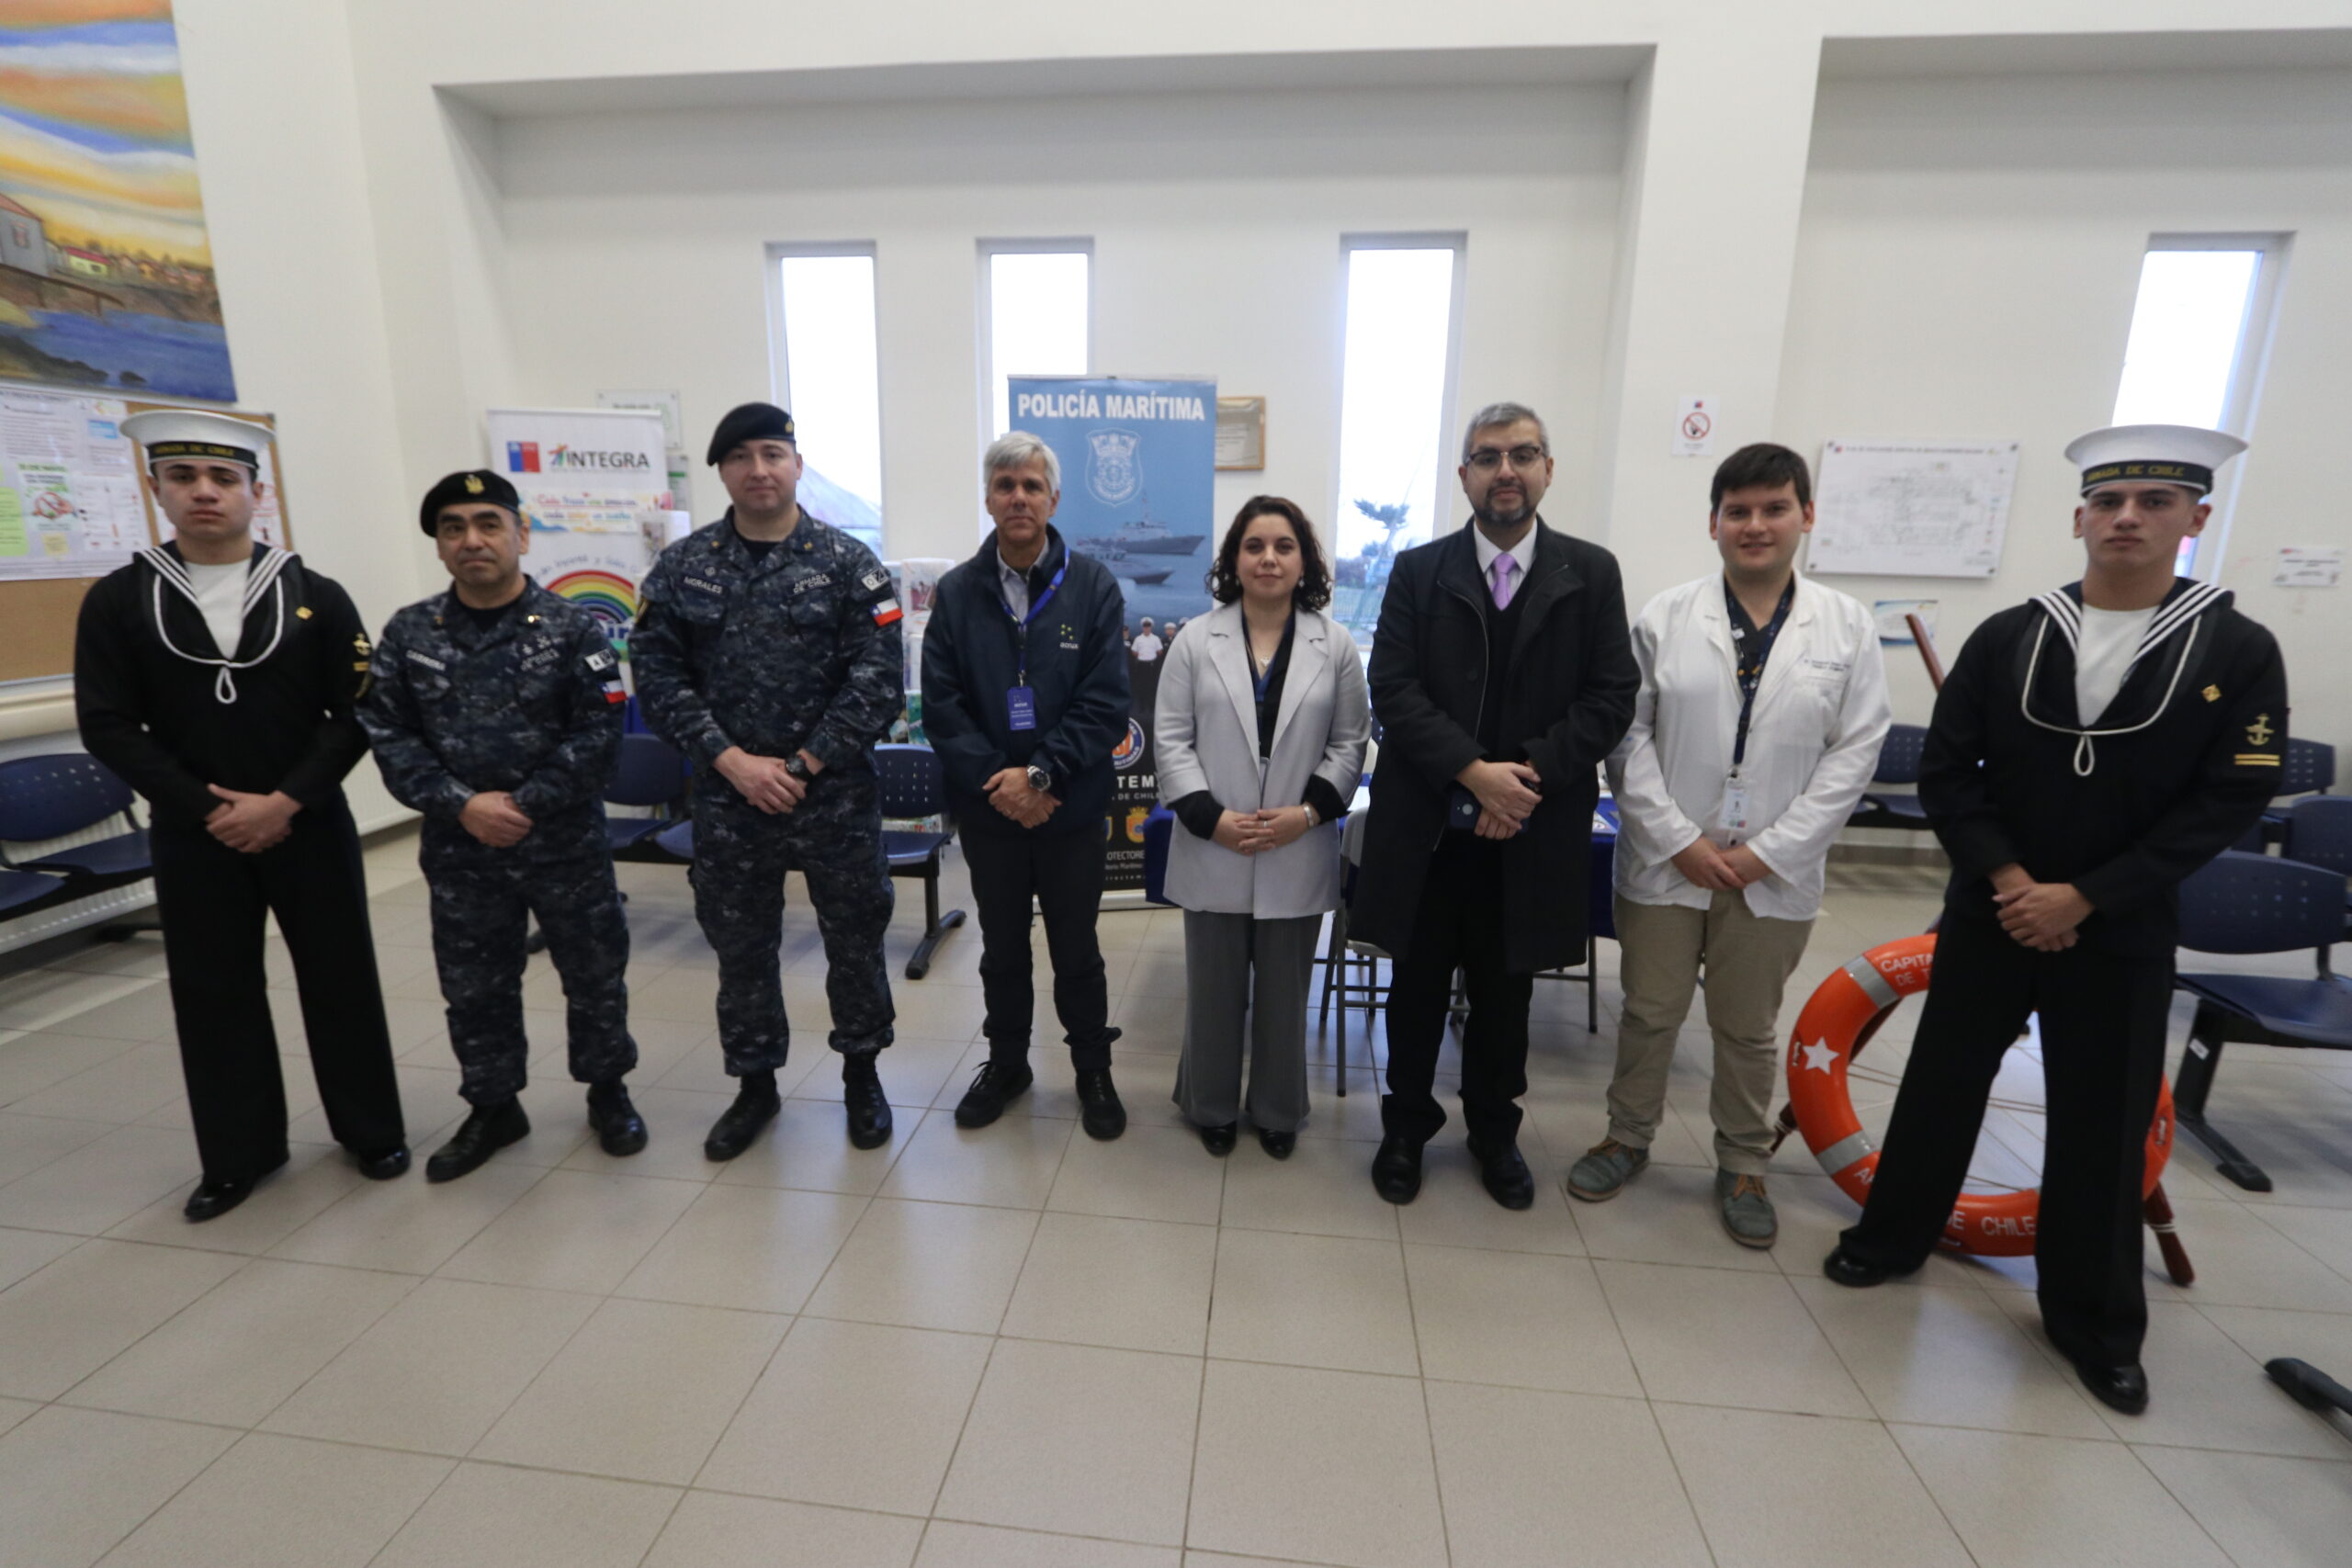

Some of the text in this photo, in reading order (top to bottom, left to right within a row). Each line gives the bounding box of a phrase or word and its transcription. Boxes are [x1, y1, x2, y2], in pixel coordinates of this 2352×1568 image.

[1017, 389, 1205, 421] POLICÍA MARÍTIMA
[566, 450, 650, 468] INTEGRA
[2125, 465, 2144, 475] DE
[2148, 465, 2185, 477] CHILE
[684, 576, 722, 594] MORALES
[1116, 774, 1156, 789] TEM
[1117, 793, 1130, 801] DE
[1981, 1215, 2036, 1236] CHILE
